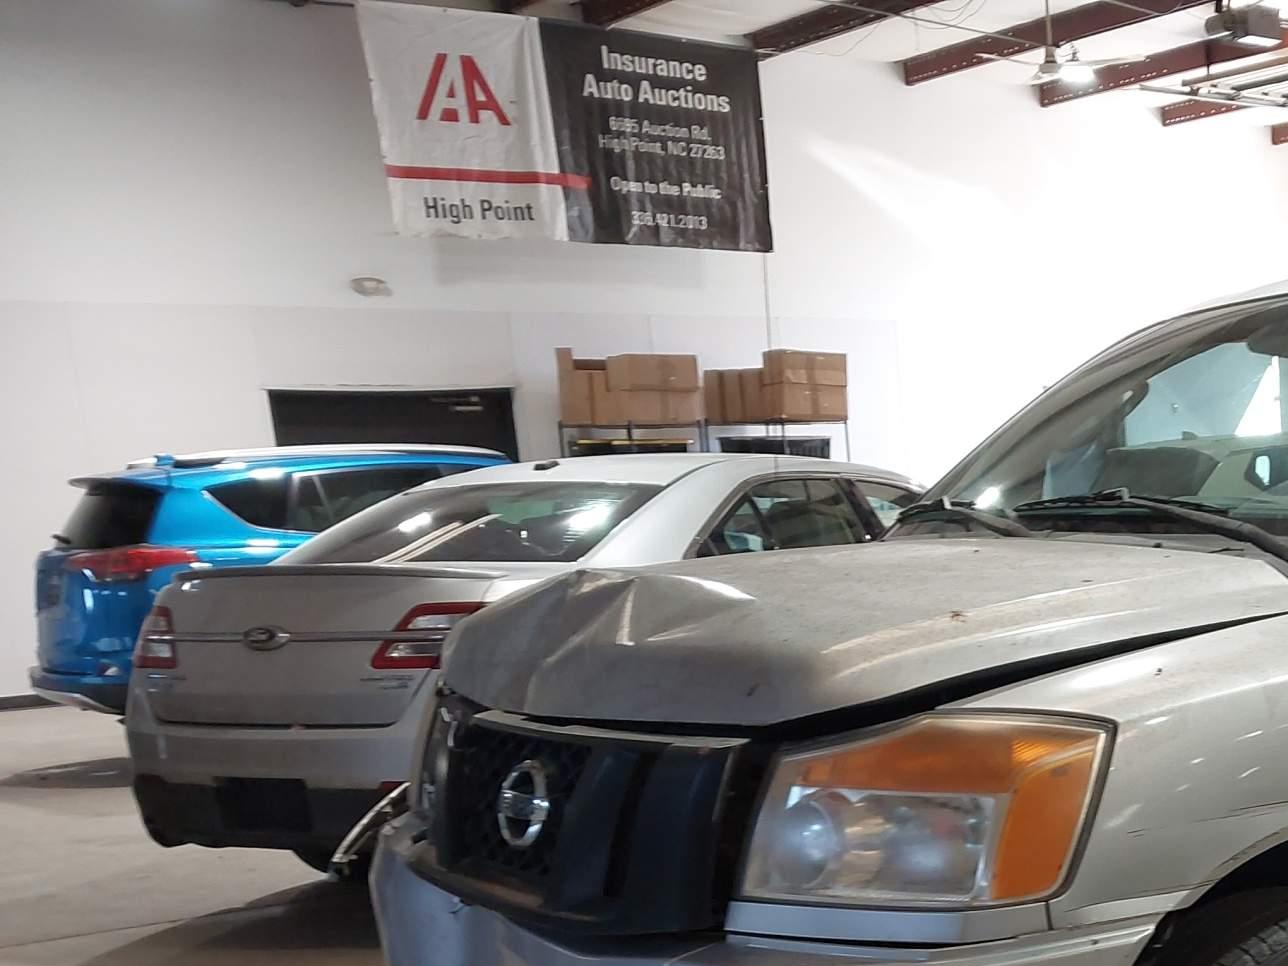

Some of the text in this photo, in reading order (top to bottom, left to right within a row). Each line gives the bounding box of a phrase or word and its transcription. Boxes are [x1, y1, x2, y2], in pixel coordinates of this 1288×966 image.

[600, 45, 707, 81] Insurance
[582, 73, 731, 112] Auto Auctions
[642, 119, 690, 138] Auction
[598, 133, 629, 152] High
[667, 141, 688, 157] NC
[610, 176, 722, 199] Open to the Public
[423, 197, 535, 224] High Point
